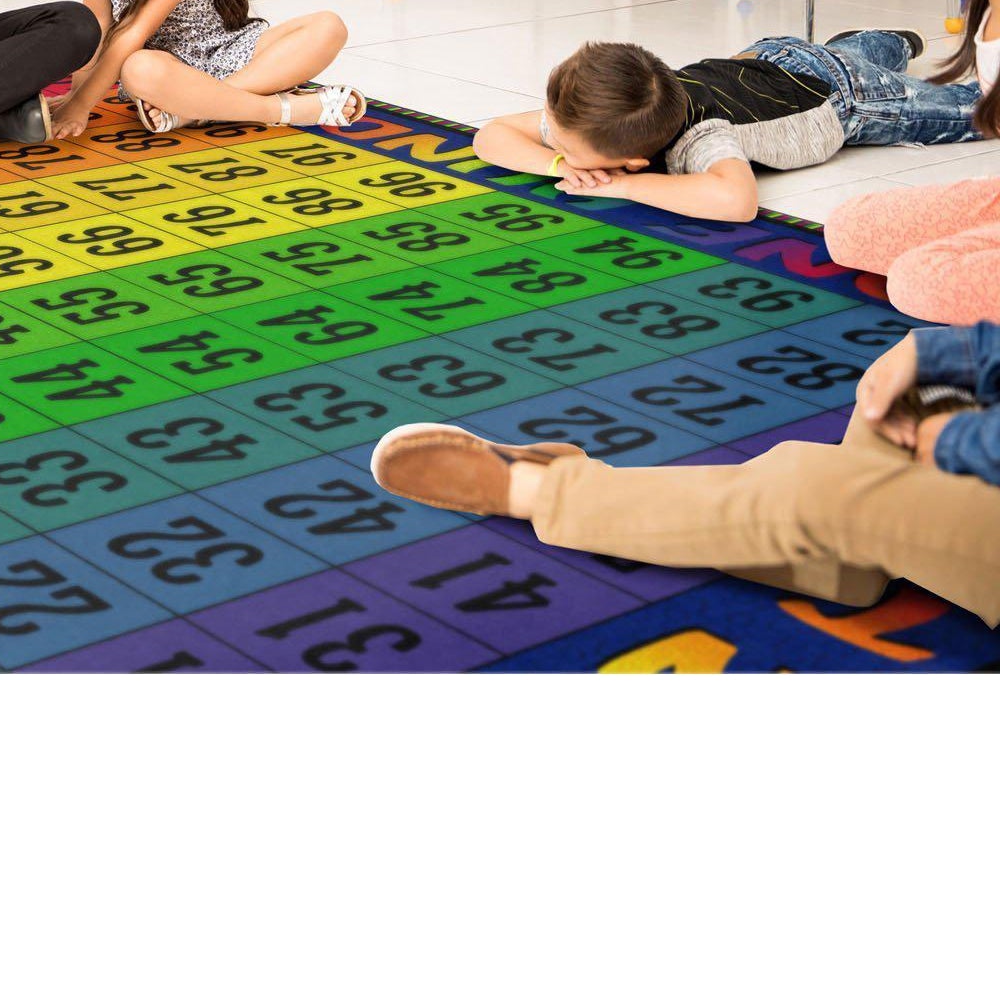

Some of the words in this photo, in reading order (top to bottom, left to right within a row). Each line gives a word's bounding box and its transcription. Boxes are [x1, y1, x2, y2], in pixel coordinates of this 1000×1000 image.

[90, 128, 182, 152] 88
[266, 143, 357, 167] 97
[73, 174, 175, 201] 77
[169, 158, 267, 181] 87
[360, 171, 457, 198] 96
[262, 188, 363, 215] 86
[460, 203, 565, 232] 95
[163, 206, 266, 236] 76
[362, 222, 470, 251] 85
[57, 226, 163, 256] 66
[261, 242, 373, 276] 75
[574, 236, 684, 269] 94
[148, 264, 264, 297] 65
[472, 258, 587, 293] 84
[30, 288, 149, 325] 55
[367, 281, 484, 321] 74
[698, 278, 814, 312] 93
[256, 305, 378, 345] 64
[600, 301, 722, 340] 83
[137, 331, 263, 375] 54
[492, 328, 617, 371] 73
[737, 345, 864, 391] 82
[11, 359, 134, 401] 44
[378, 355, 506, 398] 63
[254, 383, 388, 432] 53
[632, 375, 766, 427] 72
[126, 417, 257, 463] 43
[517, 405, 658, 458] 62
[264, 479, 404, 535] 42
[108, 516, 263, 584] 32
[412, 553, 556, 613] 41
[255, 597, 423, 674] 31
